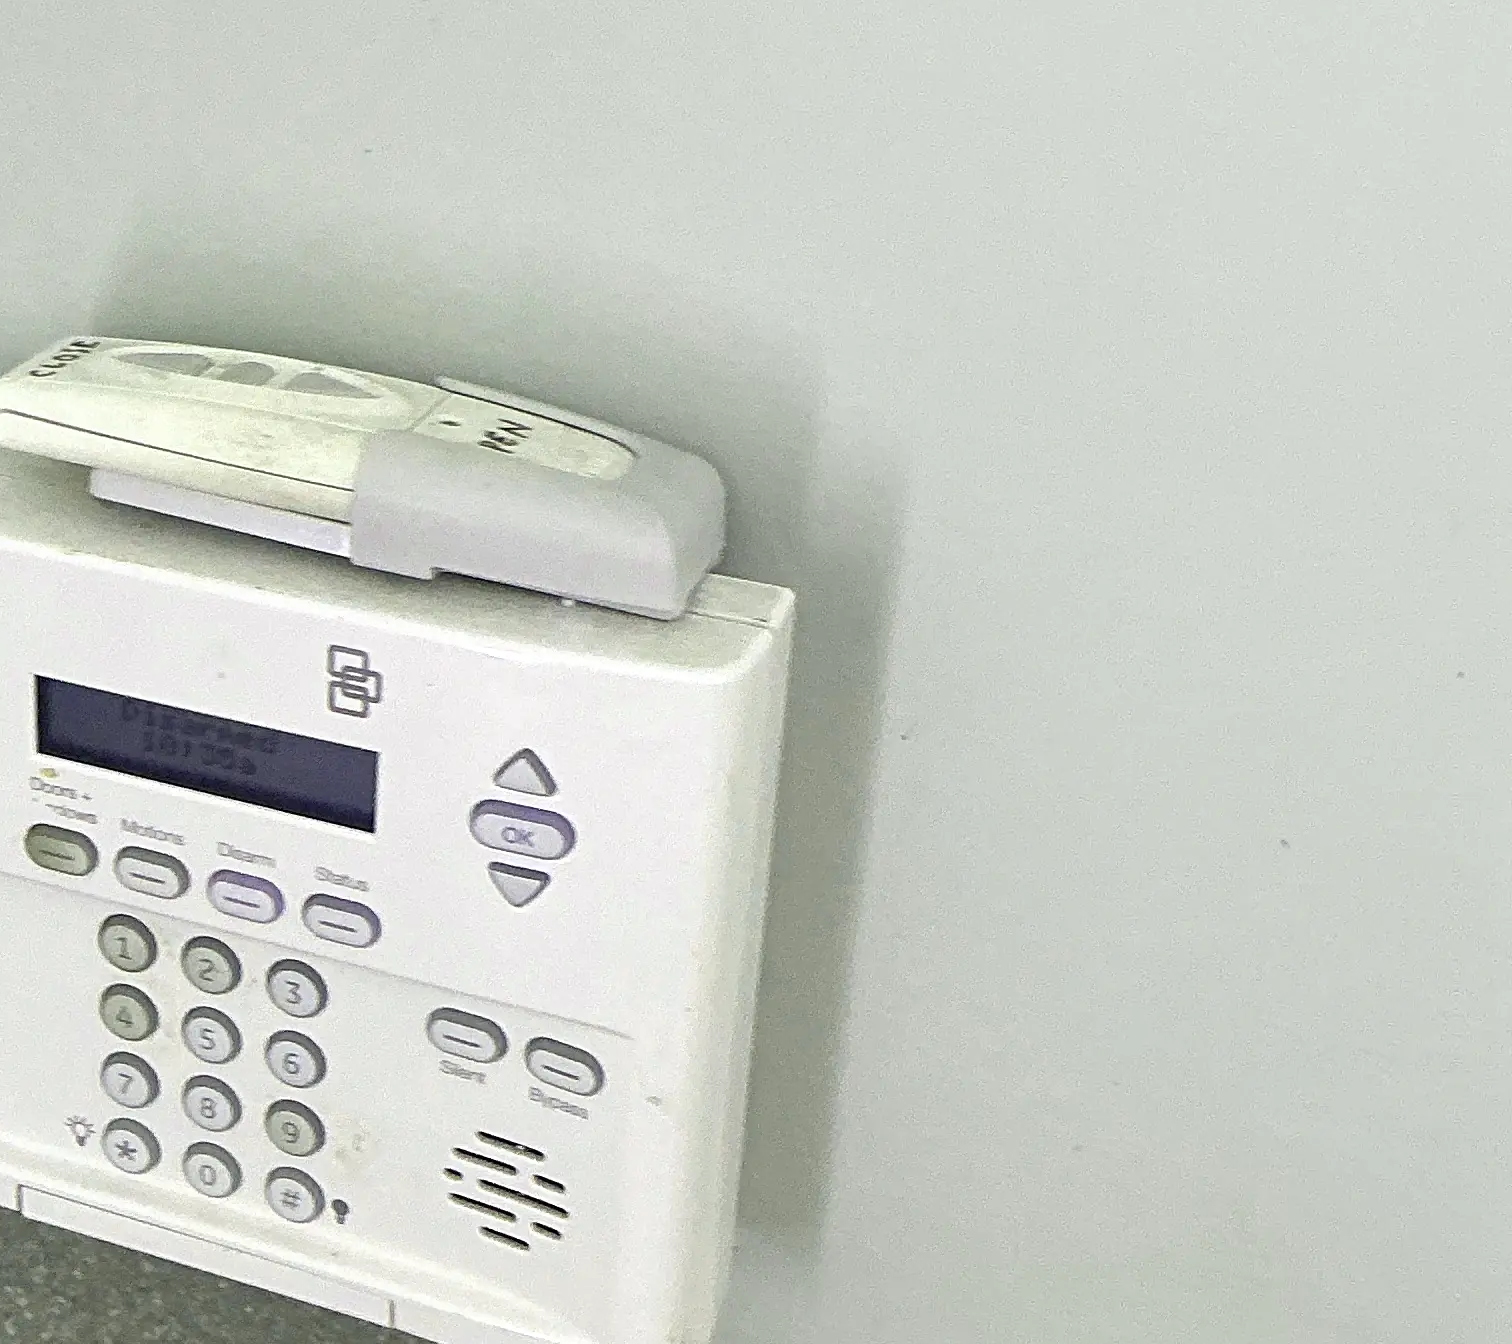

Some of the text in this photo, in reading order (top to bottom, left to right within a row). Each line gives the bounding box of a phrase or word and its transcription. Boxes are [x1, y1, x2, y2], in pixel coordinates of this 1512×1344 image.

[500, 826, 536, 848] OK
[112, 937, 131, 961] 1
[197, 958, 214, 983] 2
[283, 980, 302, 1005] 3
[115, 1005, 133, 1027] 4
[200, 1027, 217, 1051] 5
[282, 1052, 300, 1076] 6
[118, 1072, 134, 1095] 7
[199, 1097, 217, 1120] 8
[282, 1120, 301, 1145] 9
[199, 1164, 217, 1187] 0
